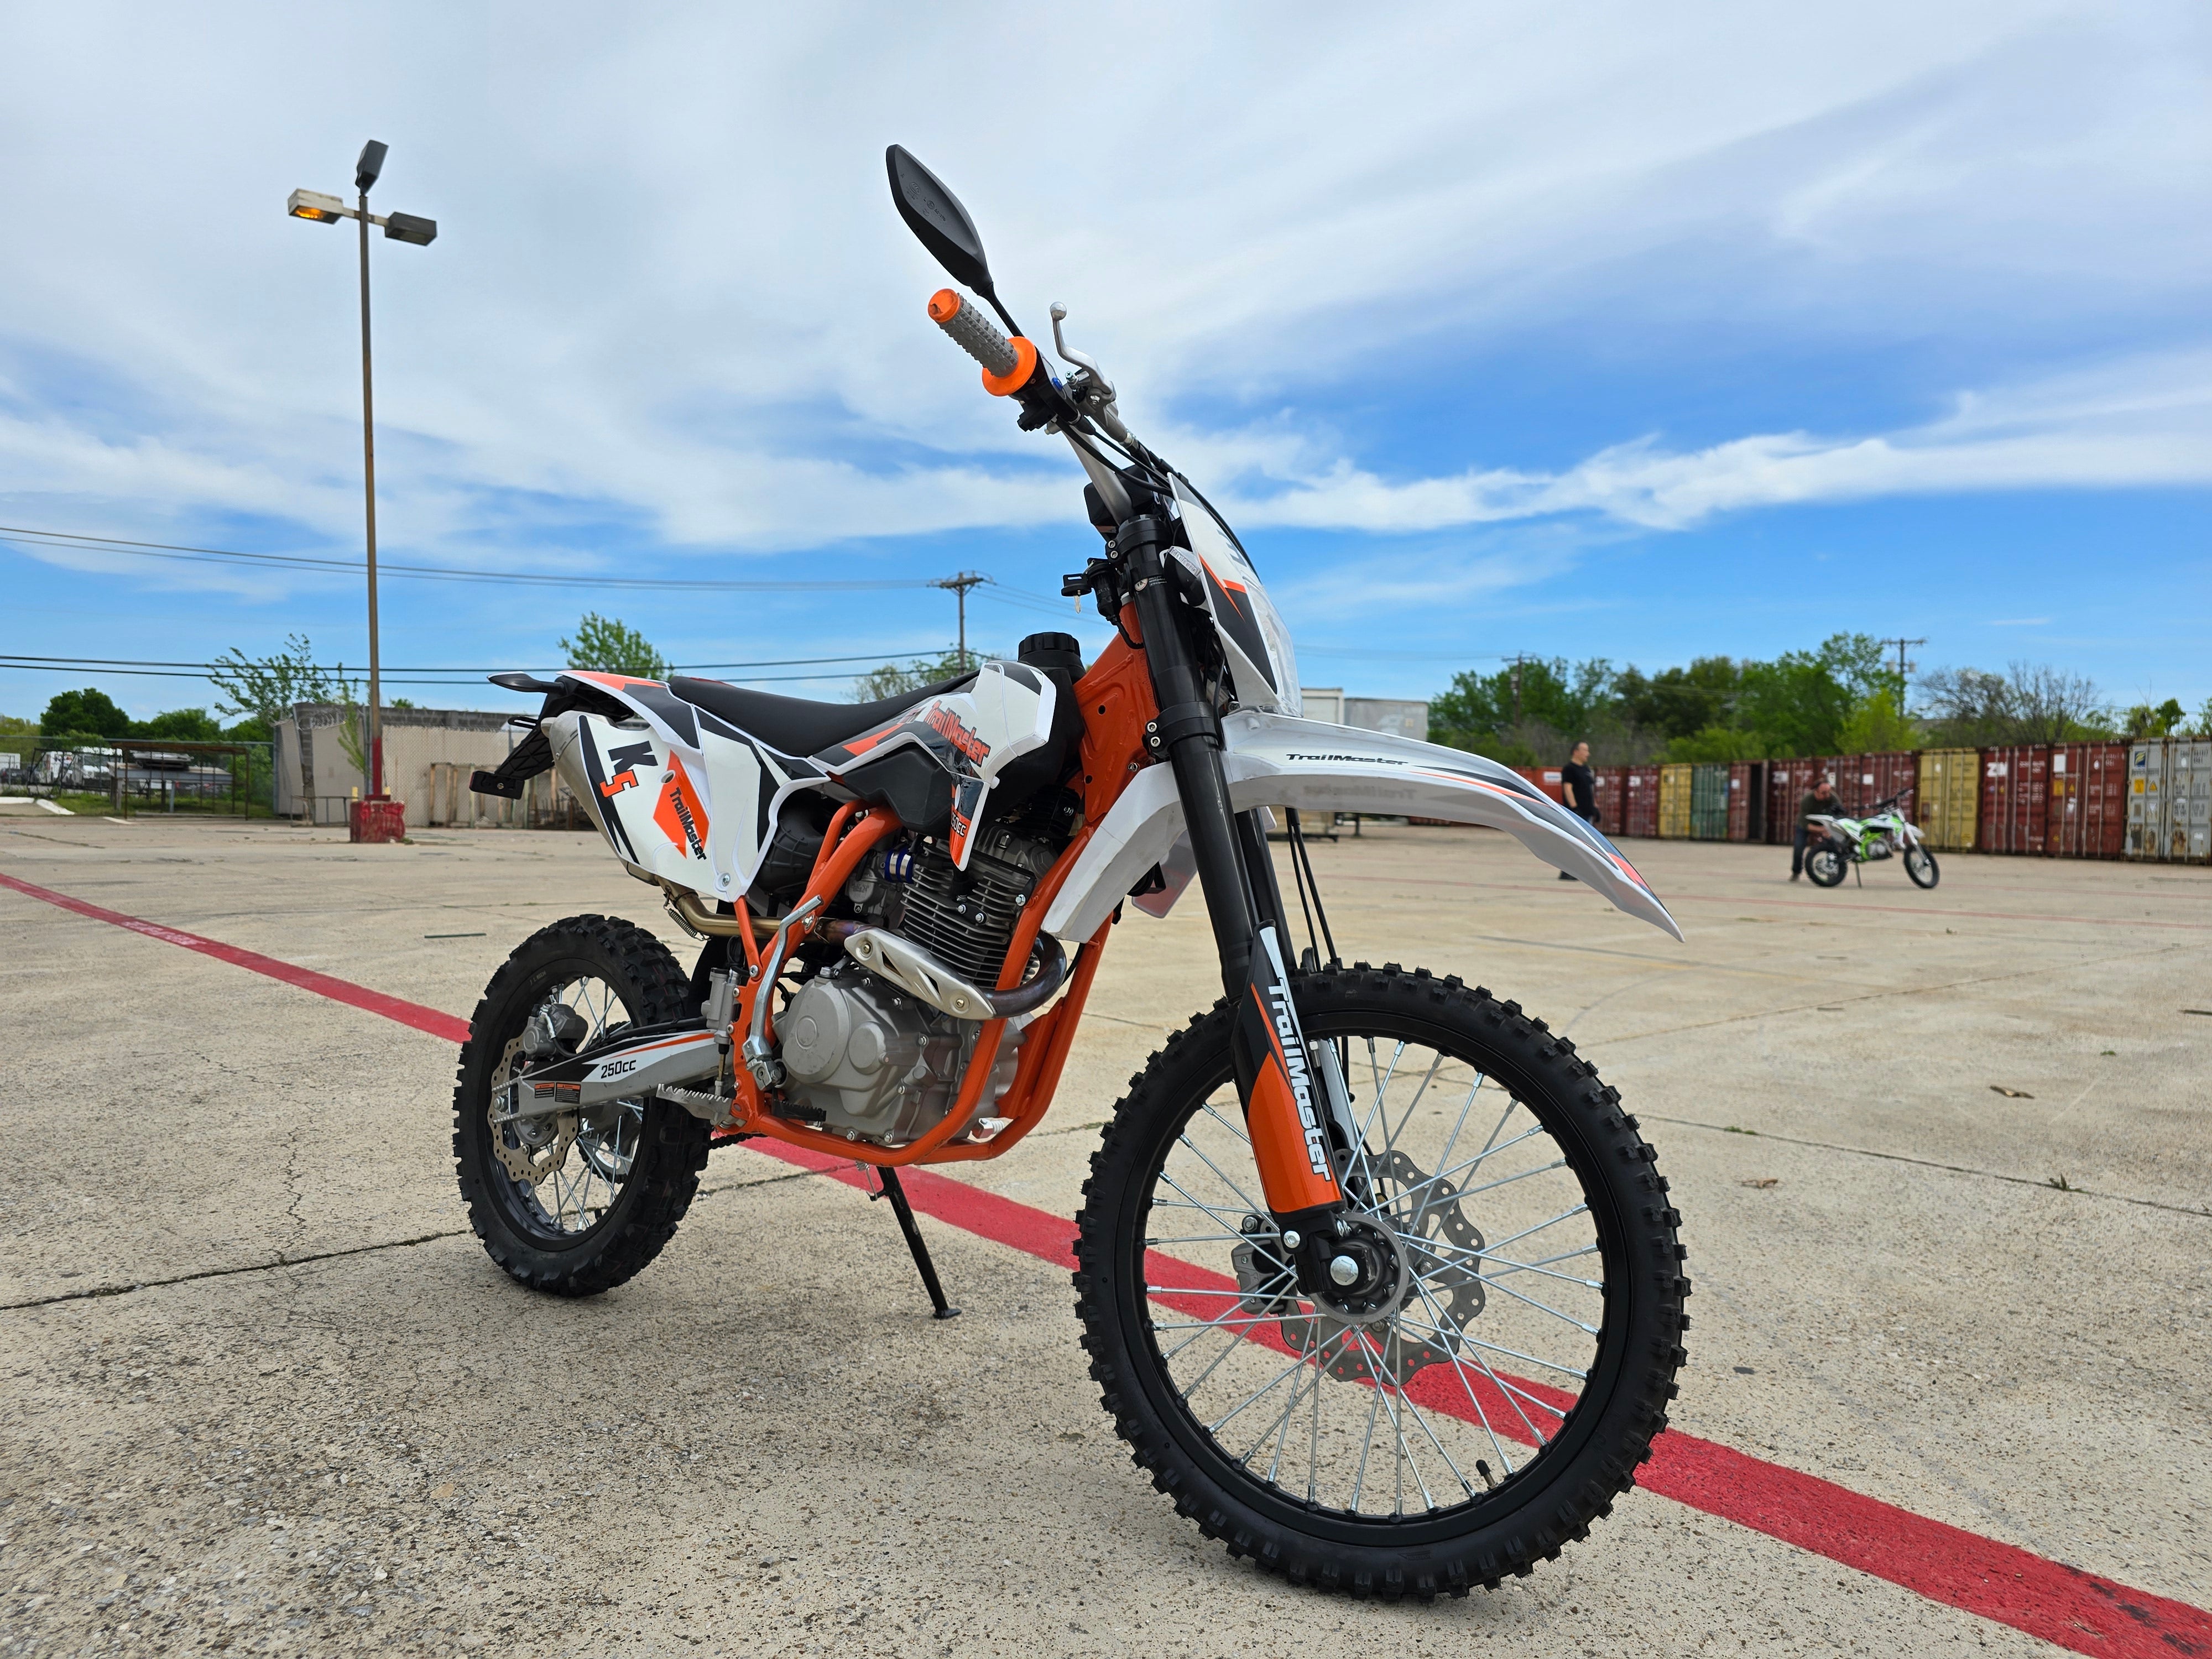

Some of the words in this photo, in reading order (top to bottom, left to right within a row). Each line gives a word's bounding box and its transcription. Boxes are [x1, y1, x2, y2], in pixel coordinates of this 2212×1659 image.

[924, 700, 991, 768] TrailMaster
[1286, 754, 1408, 765] TrailMaster
[670, 787, 707, 861] TrailMaster
[602, 1060, 636, 1079] 250cc
[1267, 977, 1332, 1181] TrailMaster
